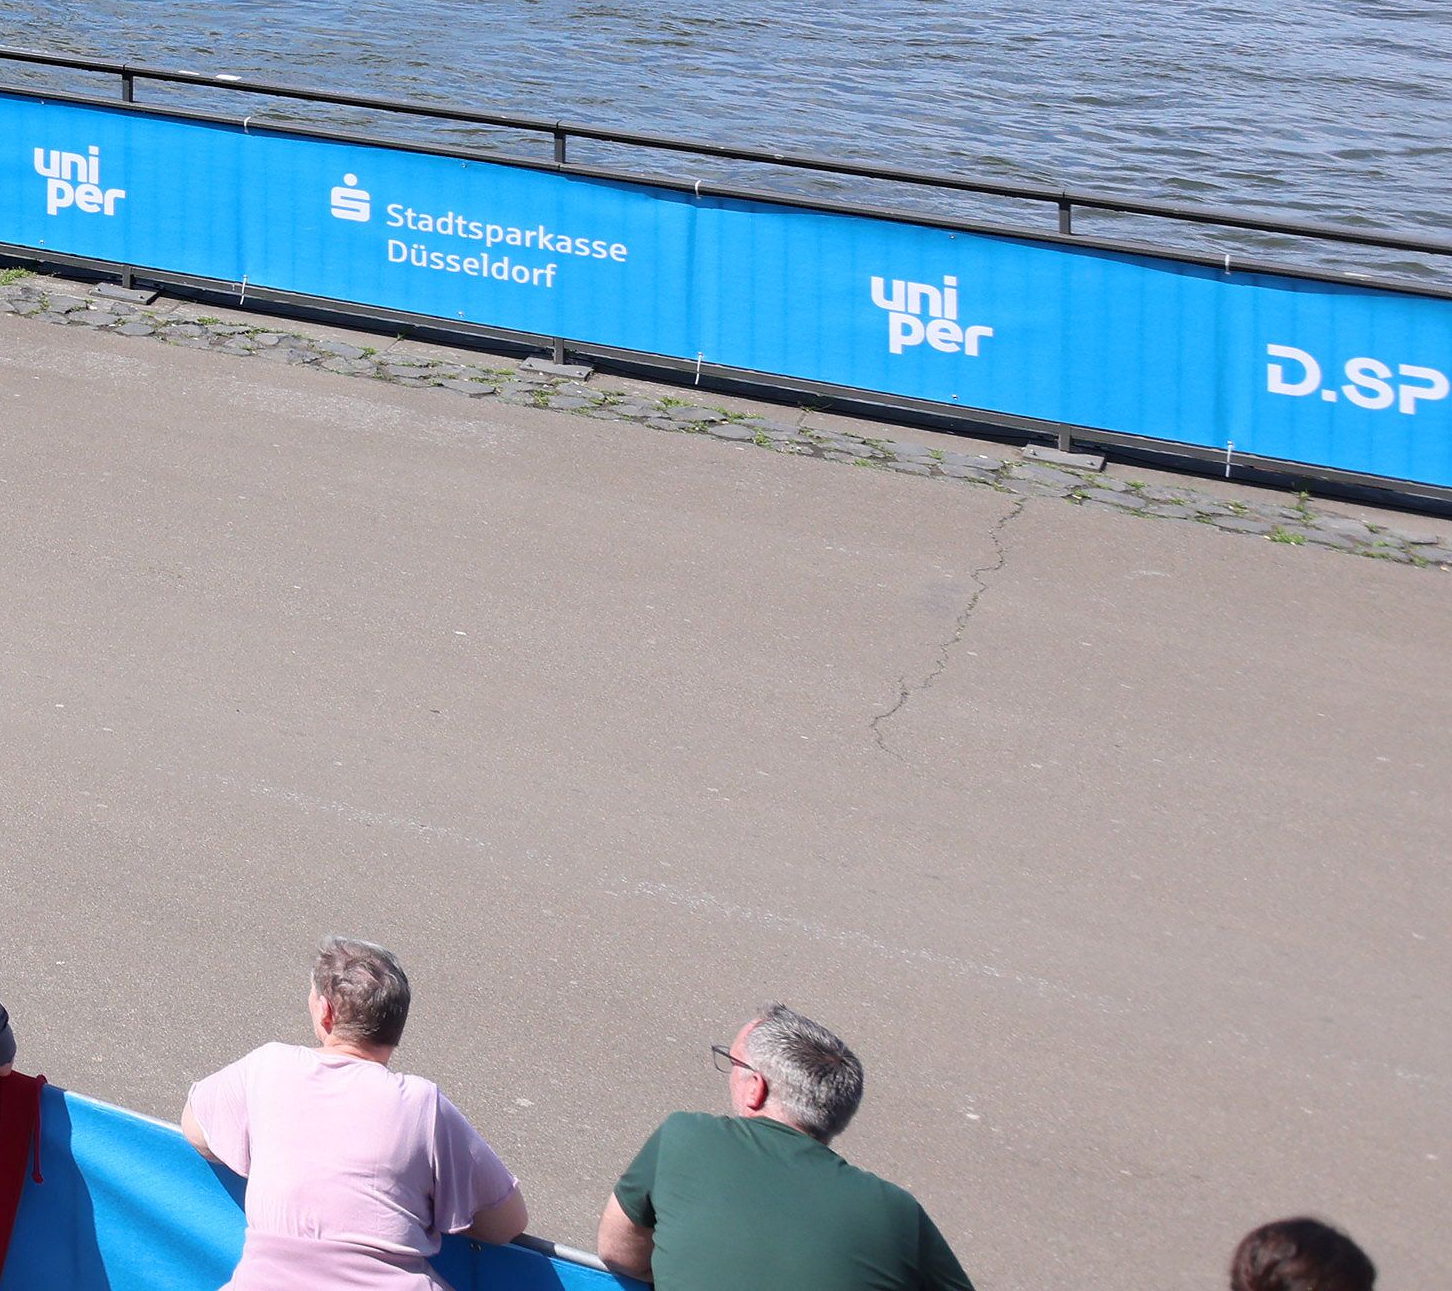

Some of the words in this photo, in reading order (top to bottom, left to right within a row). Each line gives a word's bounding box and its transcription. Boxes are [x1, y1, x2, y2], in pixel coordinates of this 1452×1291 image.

[34, 146, 99, 188] uni
[47, 177, 125, 215] per
[387, 204, 628, 268] Stadtsparkasse
[388, 233, 562, 287] Düsseldorf
[871, 276, 957, 321] uni
[889, 309, 993, 356] per
